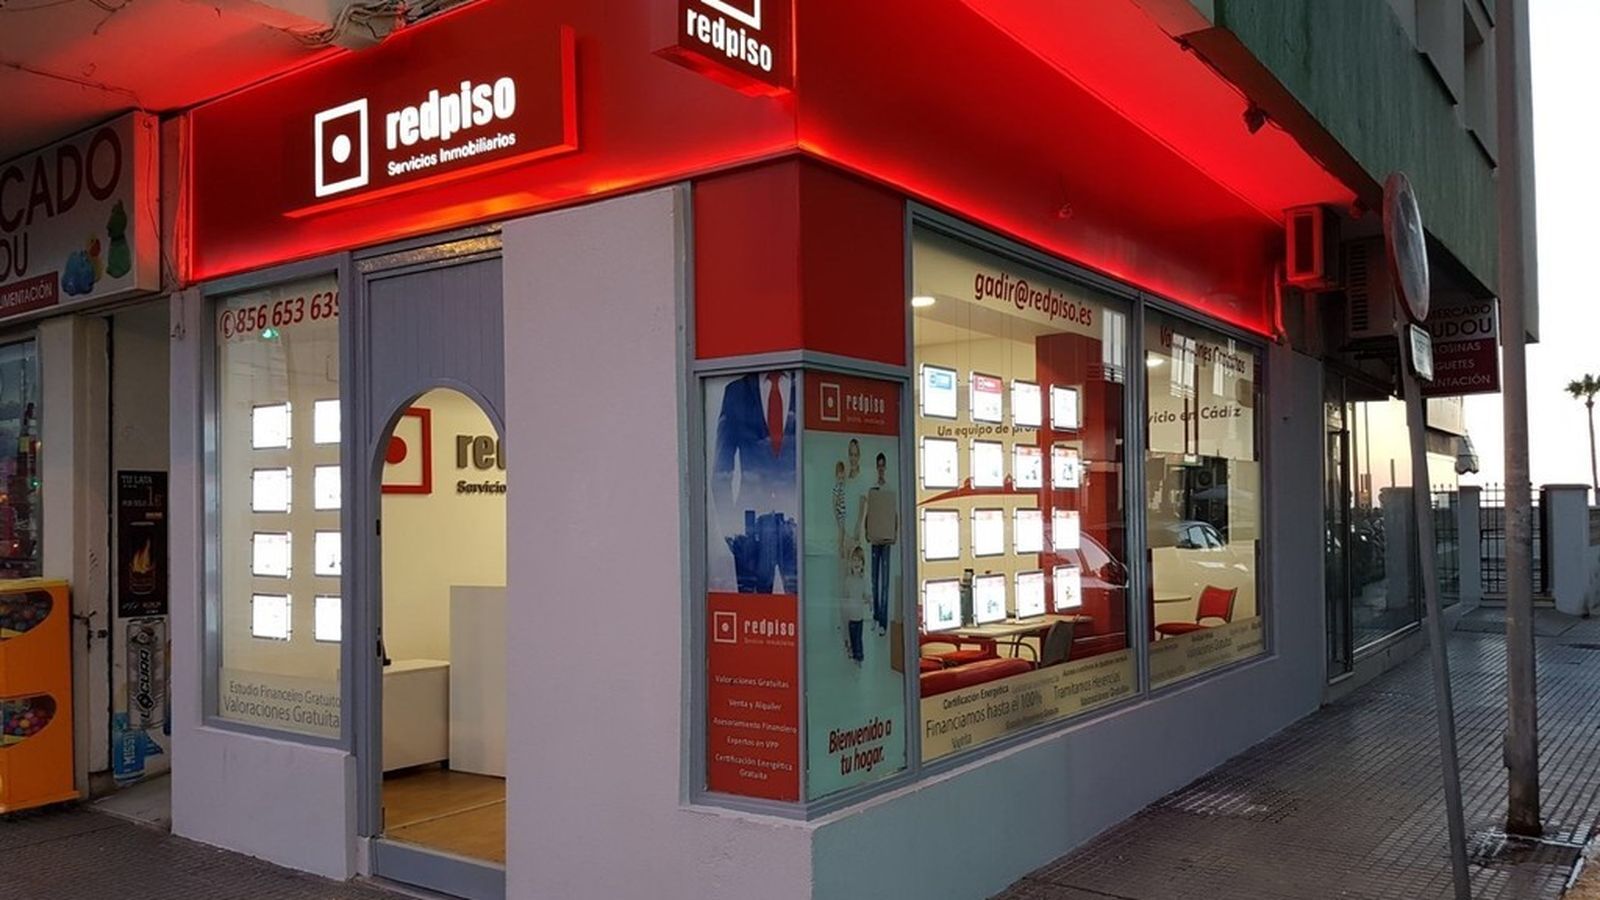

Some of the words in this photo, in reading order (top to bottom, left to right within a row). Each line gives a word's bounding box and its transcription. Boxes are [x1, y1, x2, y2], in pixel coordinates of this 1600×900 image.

[687, 8, 772, 72] redpiso
[386, 77, 516, 150] redpiso
[387, 153, 437, 176] Servicios
[440, 133, 516, 163] Inmobiliarios
[974, 272, 1093, 326] gadir@redpiso.es
[236, 304, 267, 333] 856
[272, 297, 304, 327] 653
[846, 394, 884, 414] redpiso
[1201, 406, 1241, 420] Cádiz
[937, 426, 953, 437] Un
[995, 425, 1009, 434] de
[744, 619, 795, 637] redpiso
[224, 696, 290, 721] Valoraciones
[926, 708, 986, 738] Financiamos
[829, 716, 884, 754] Bienvenido
[886, 720, 891, 736] a
[841, 755, 852, 775] tu
